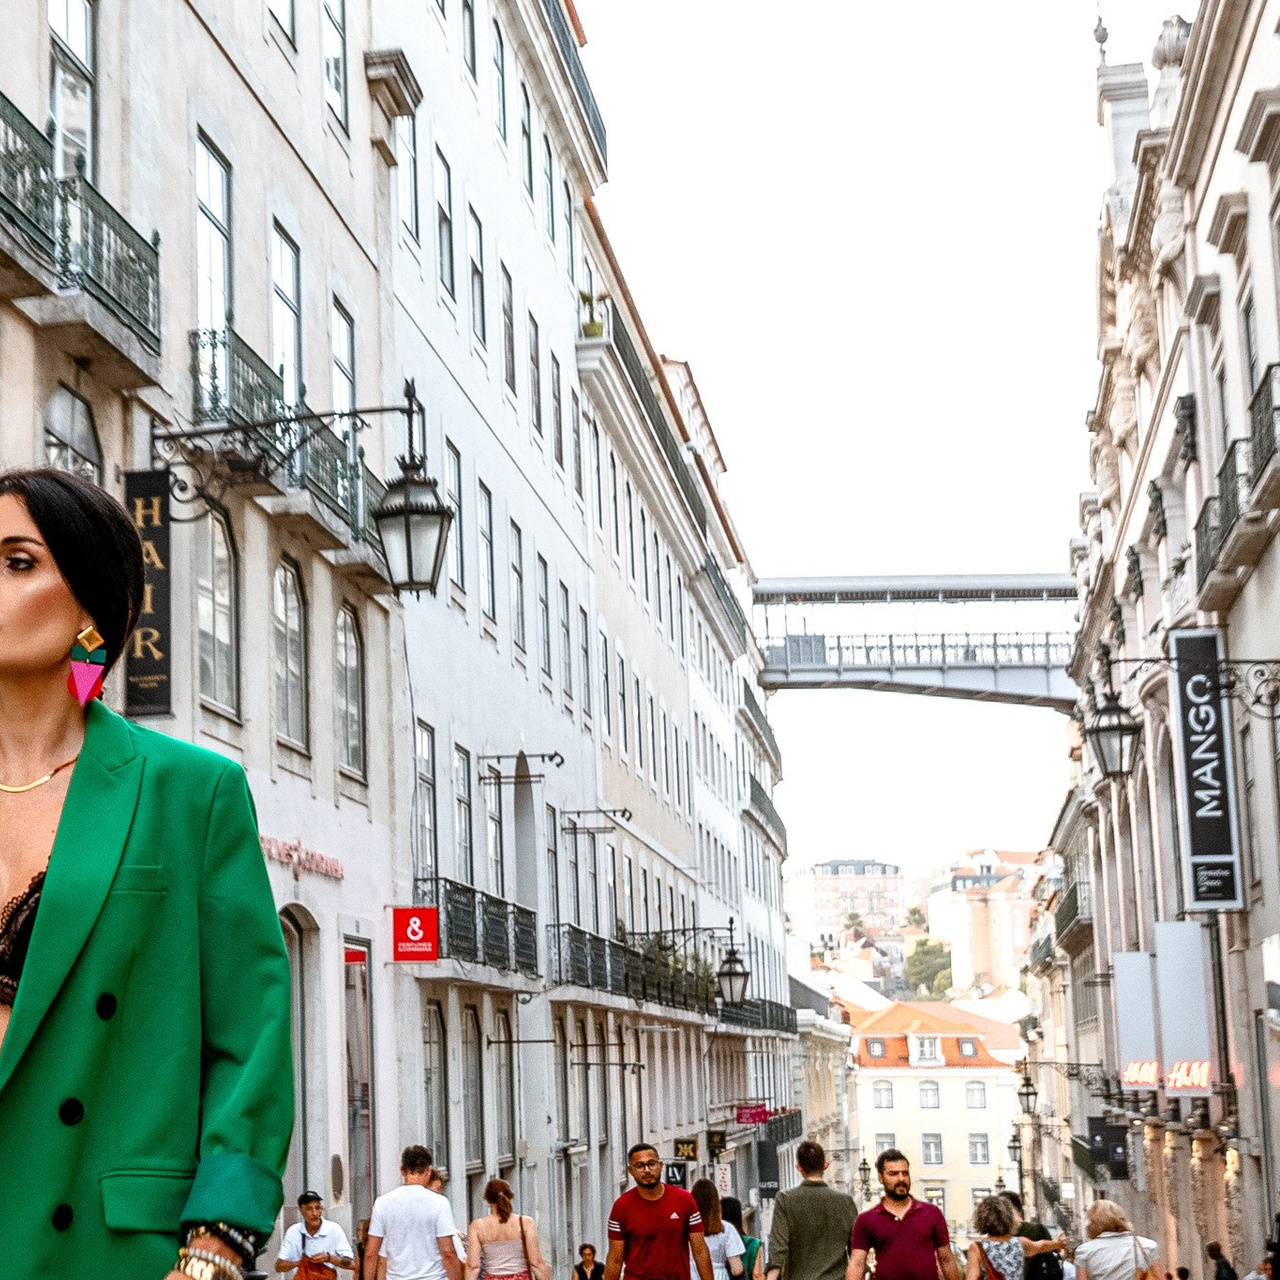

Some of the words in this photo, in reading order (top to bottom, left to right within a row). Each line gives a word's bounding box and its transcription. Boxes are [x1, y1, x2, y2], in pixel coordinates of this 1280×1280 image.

[133, 496, 166, 661] HAIR
[1186, 673, 1223, 818] MANGO
[1166, 1060, 1211, 1089] H&M
